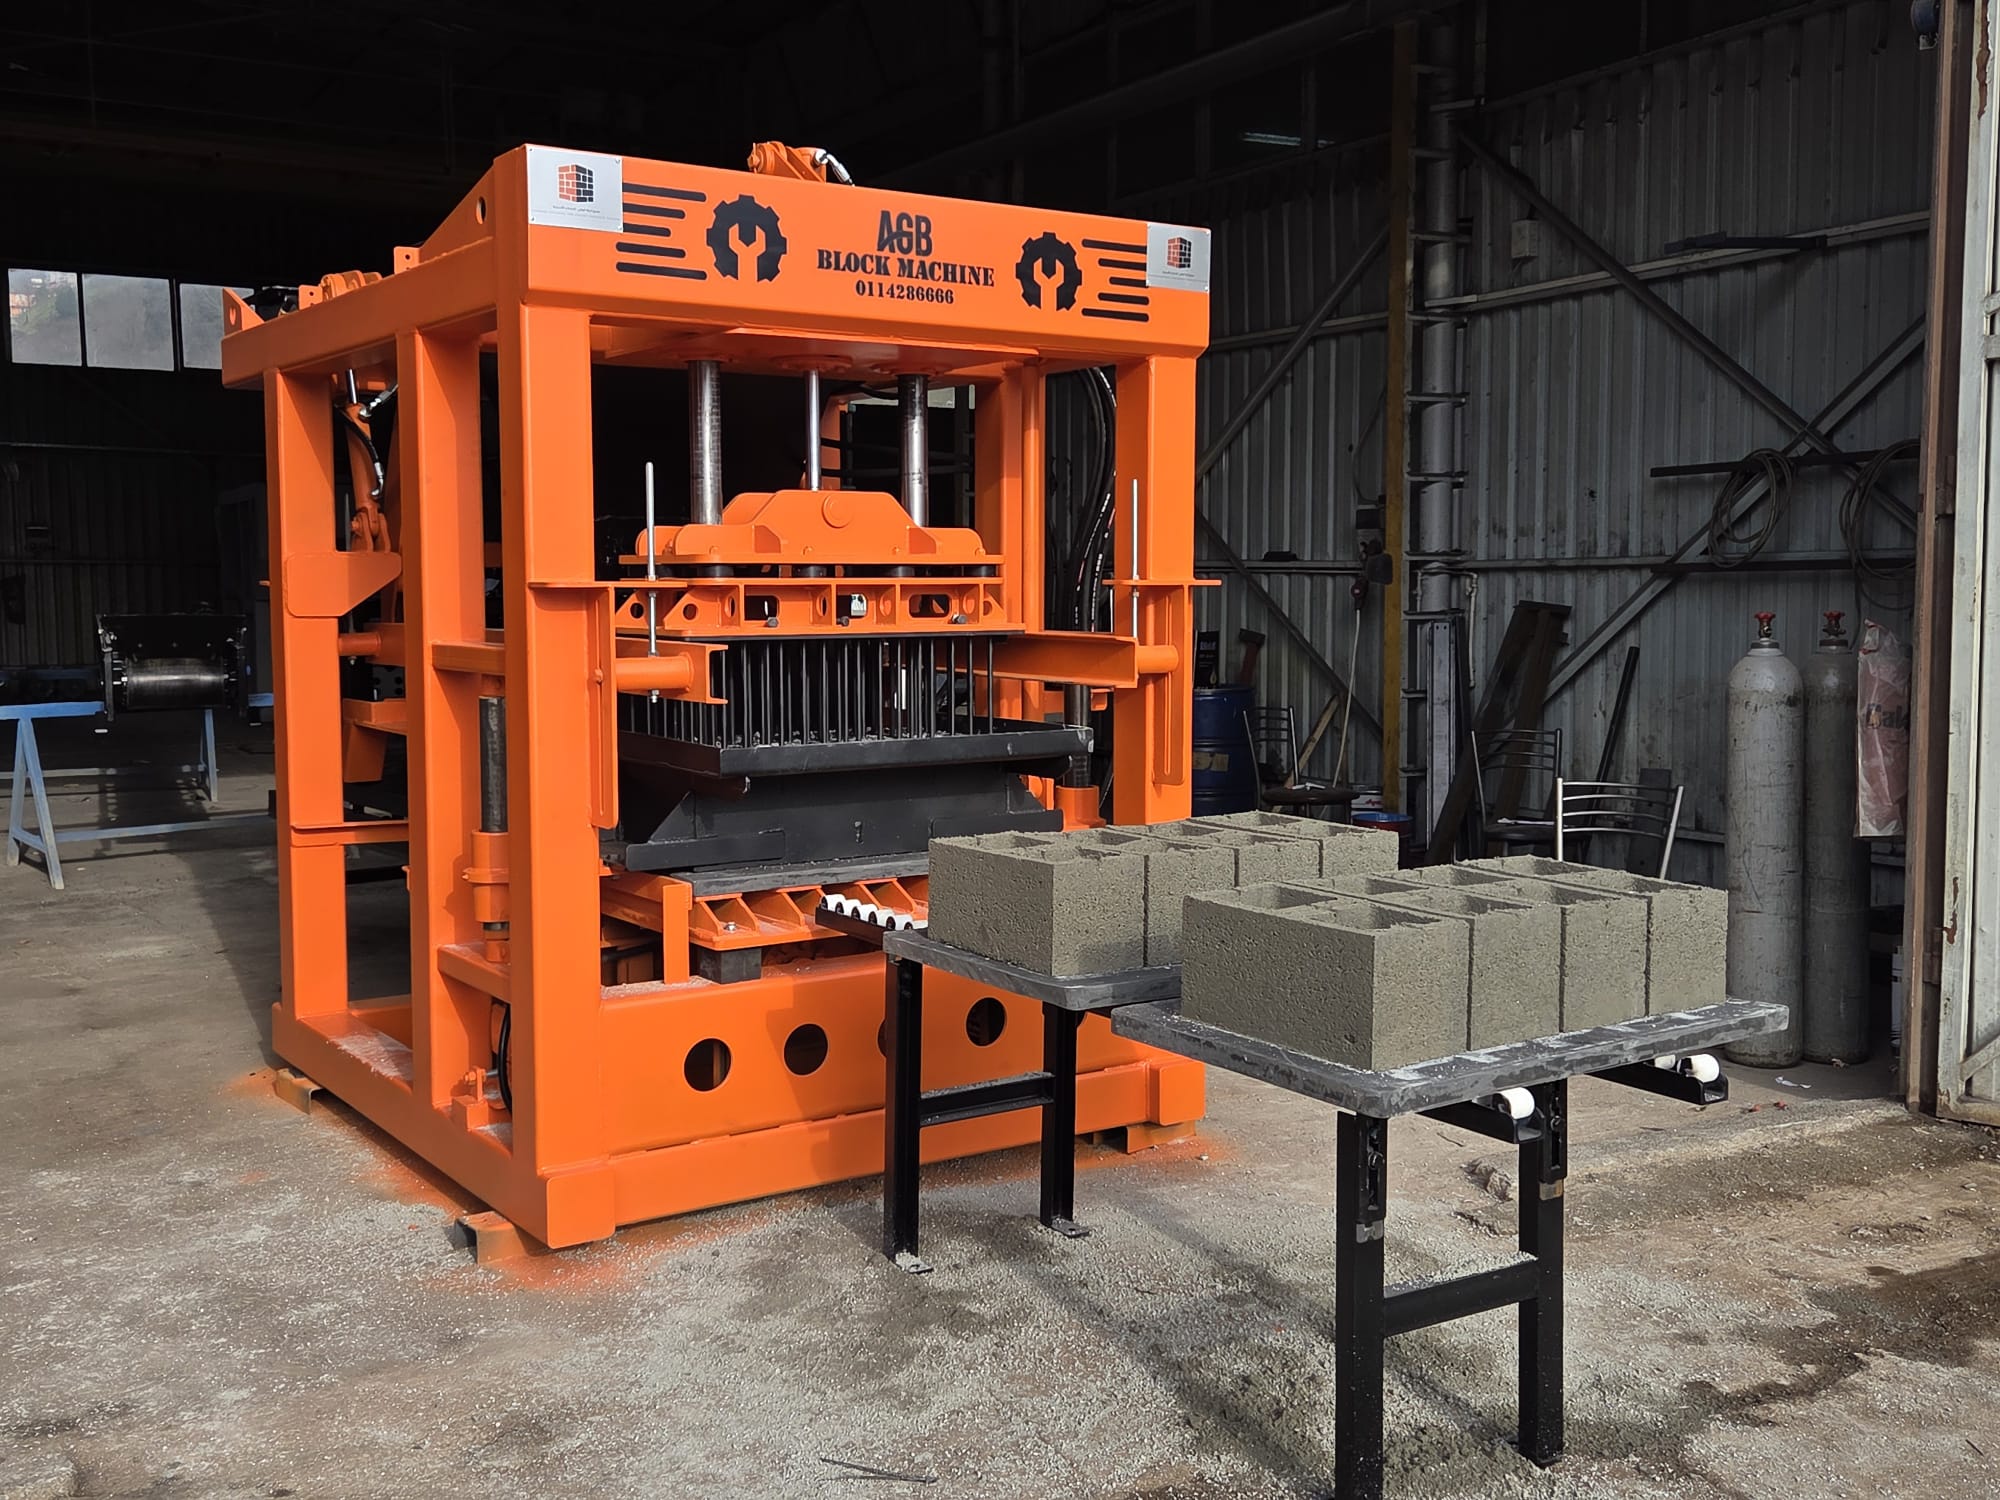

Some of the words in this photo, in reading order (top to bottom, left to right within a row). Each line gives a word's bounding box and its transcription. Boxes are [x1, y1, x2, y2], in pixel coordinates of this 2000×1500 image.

[876, 210, 933, 257] AGB
[817, 249, 891, 276] BLOCK
[897, 258, 995, 287] MACHINE
[855, 279, 954, 304] 0114286666
